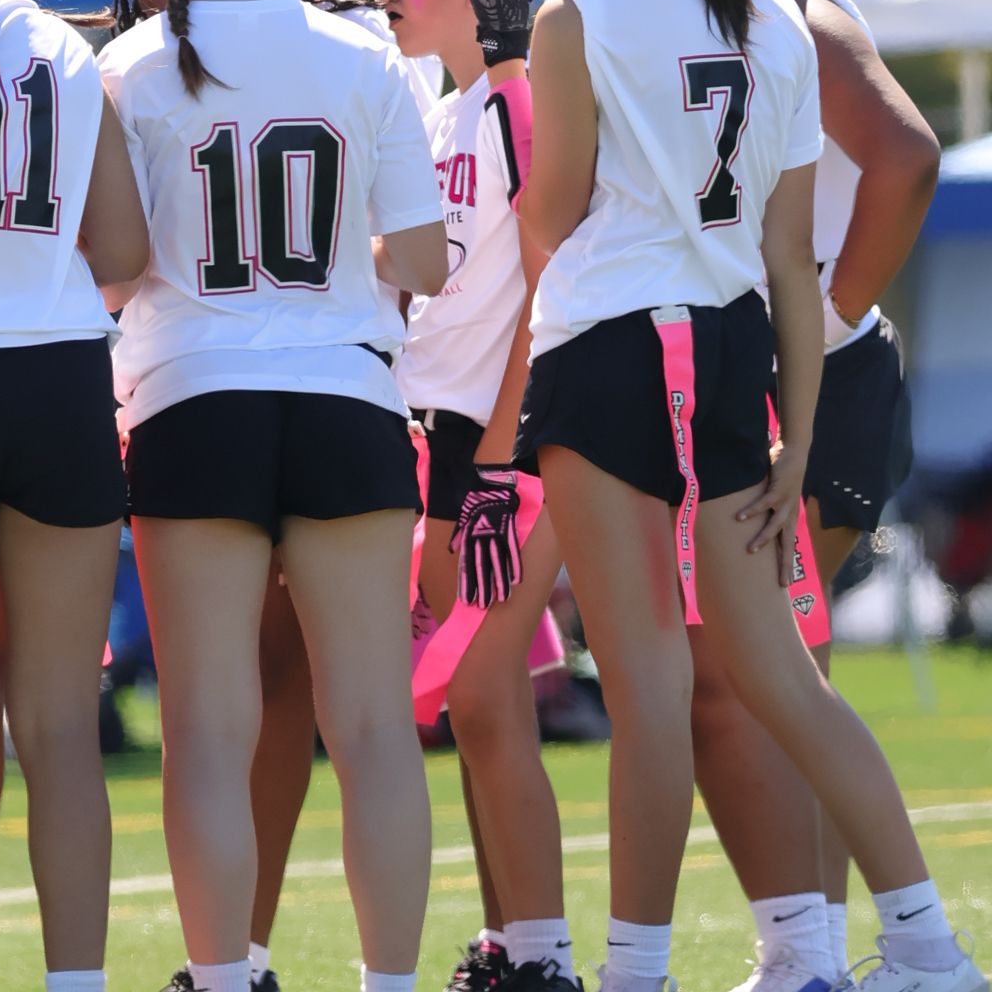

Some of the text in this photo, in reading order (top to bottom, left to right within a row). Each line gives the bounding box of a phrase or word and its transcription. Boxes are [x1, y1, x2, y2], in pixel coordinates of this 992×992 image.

[190, 117, 346, 296] 10
[445, 211, 463, 225] ITE
[678, 52, 755, 231] 7
